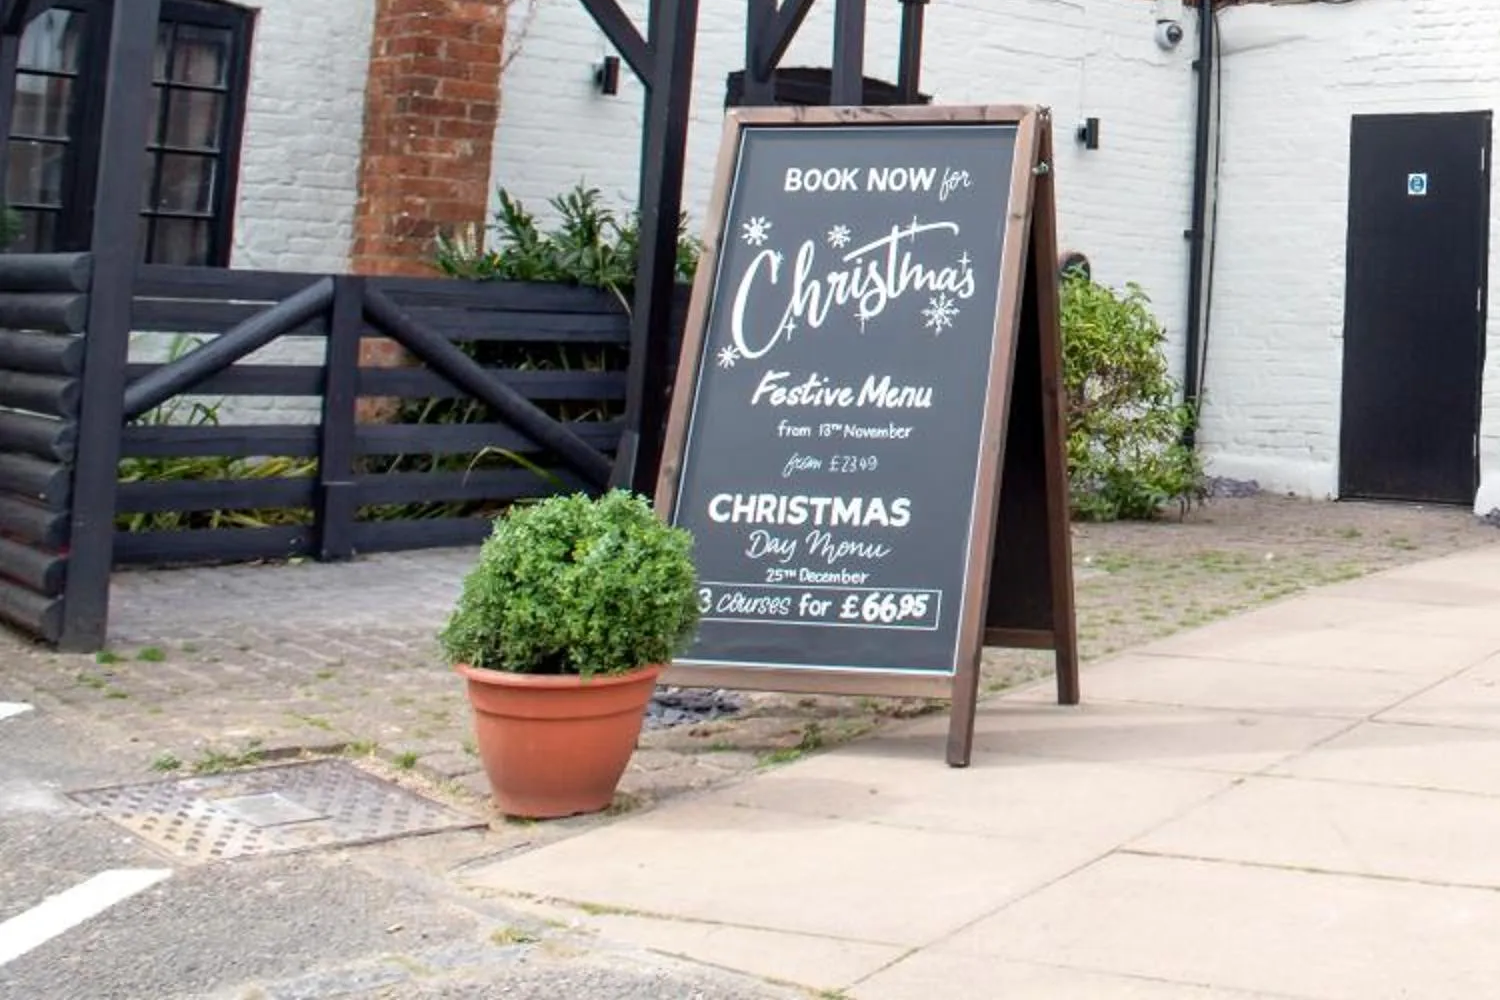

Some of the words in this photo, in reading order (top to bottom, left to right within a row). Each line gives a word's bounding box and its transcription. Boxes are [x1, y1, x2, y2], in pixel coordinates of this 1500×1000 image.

[783, 167, 860, 192] BOOK
[866, 167, 937, 192] NOW
[939, 167, 972, 202] for
[731, 221, 976, 359] Christmas
[751, 370, 855, 408] Festive
[856, 375, 933, 409] Menu
[776, 419, 812, 438] from
[843, 422, 914, 440] November
[708, 493, 912, 528] CHRISTMAS
[744, 529, 797, 564] Day
[765, 567, 797, 583] 25TH
[799, 567, 870, 585] December
[699, 588, 712, 614] 3
[715, 591, 791, 616] courses
[798, 592, 833, 617] for
